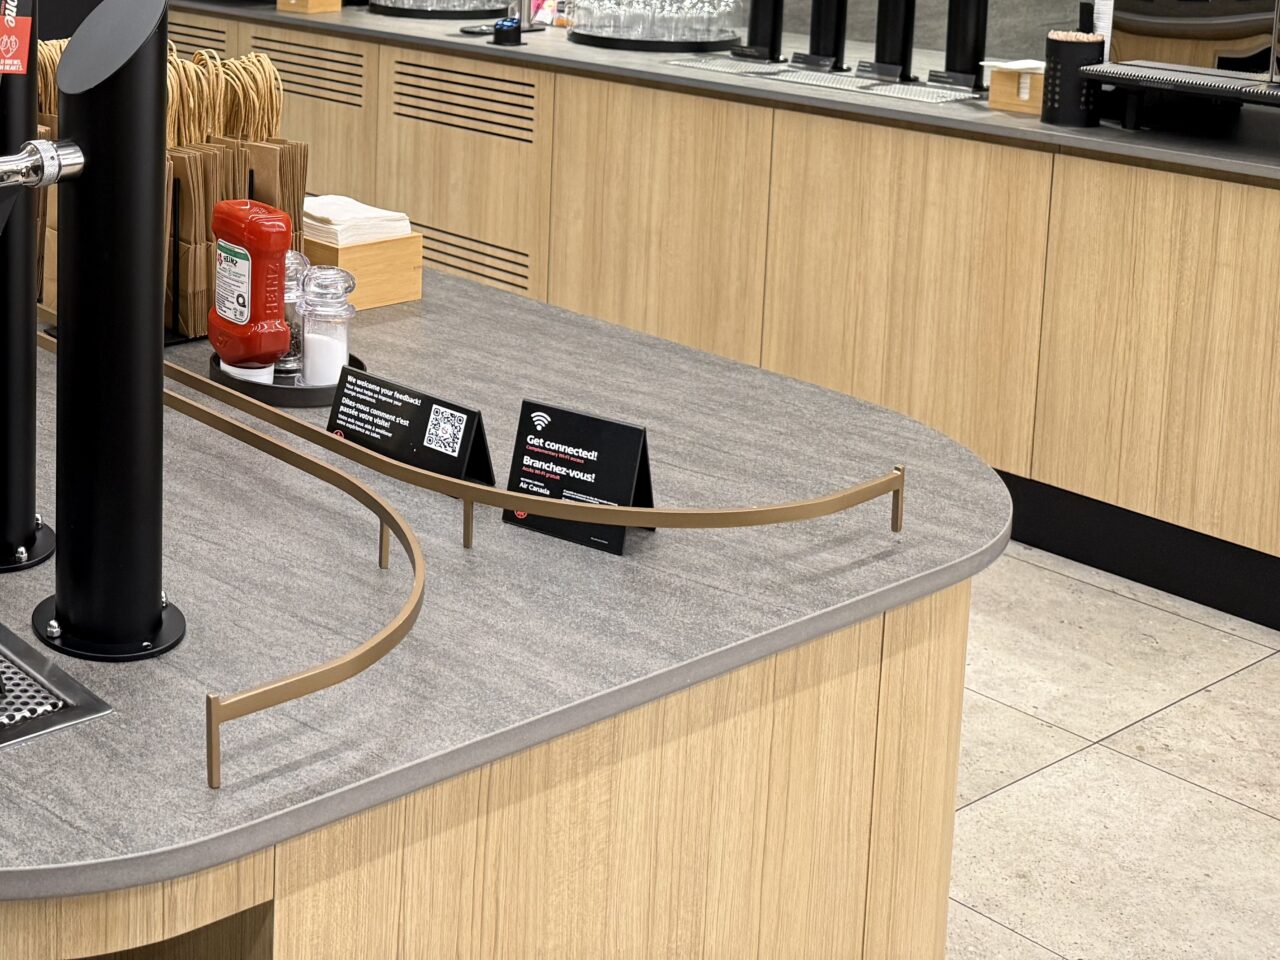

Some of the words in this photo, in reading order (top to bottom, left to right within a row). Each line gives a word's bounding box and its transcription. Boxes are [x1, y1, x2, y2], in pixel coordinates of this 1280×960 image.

[223, 255, 238, 267] HEINZ
[347, 375, 356, 383] We
[356, 379, 380, 391] welcome
[380, 387, 393, 396] your
[393, 391, 421, 405] feedback!
[339, 405, 358, 416] passée
[358, 412, 373, 421] votre
[373, 417, 390, 428] visite!
[341, 396, 369, 412] Dites-nous
[370, 408, 395, 421] comment
[395, 417, 409, 426] s'est
[526, 435, 544, 446] Get
[545, 441, 597, 460] connected!
[523, 455, 595, 482] Branchez-vous!
[528, 484, 550, 495] Canada
